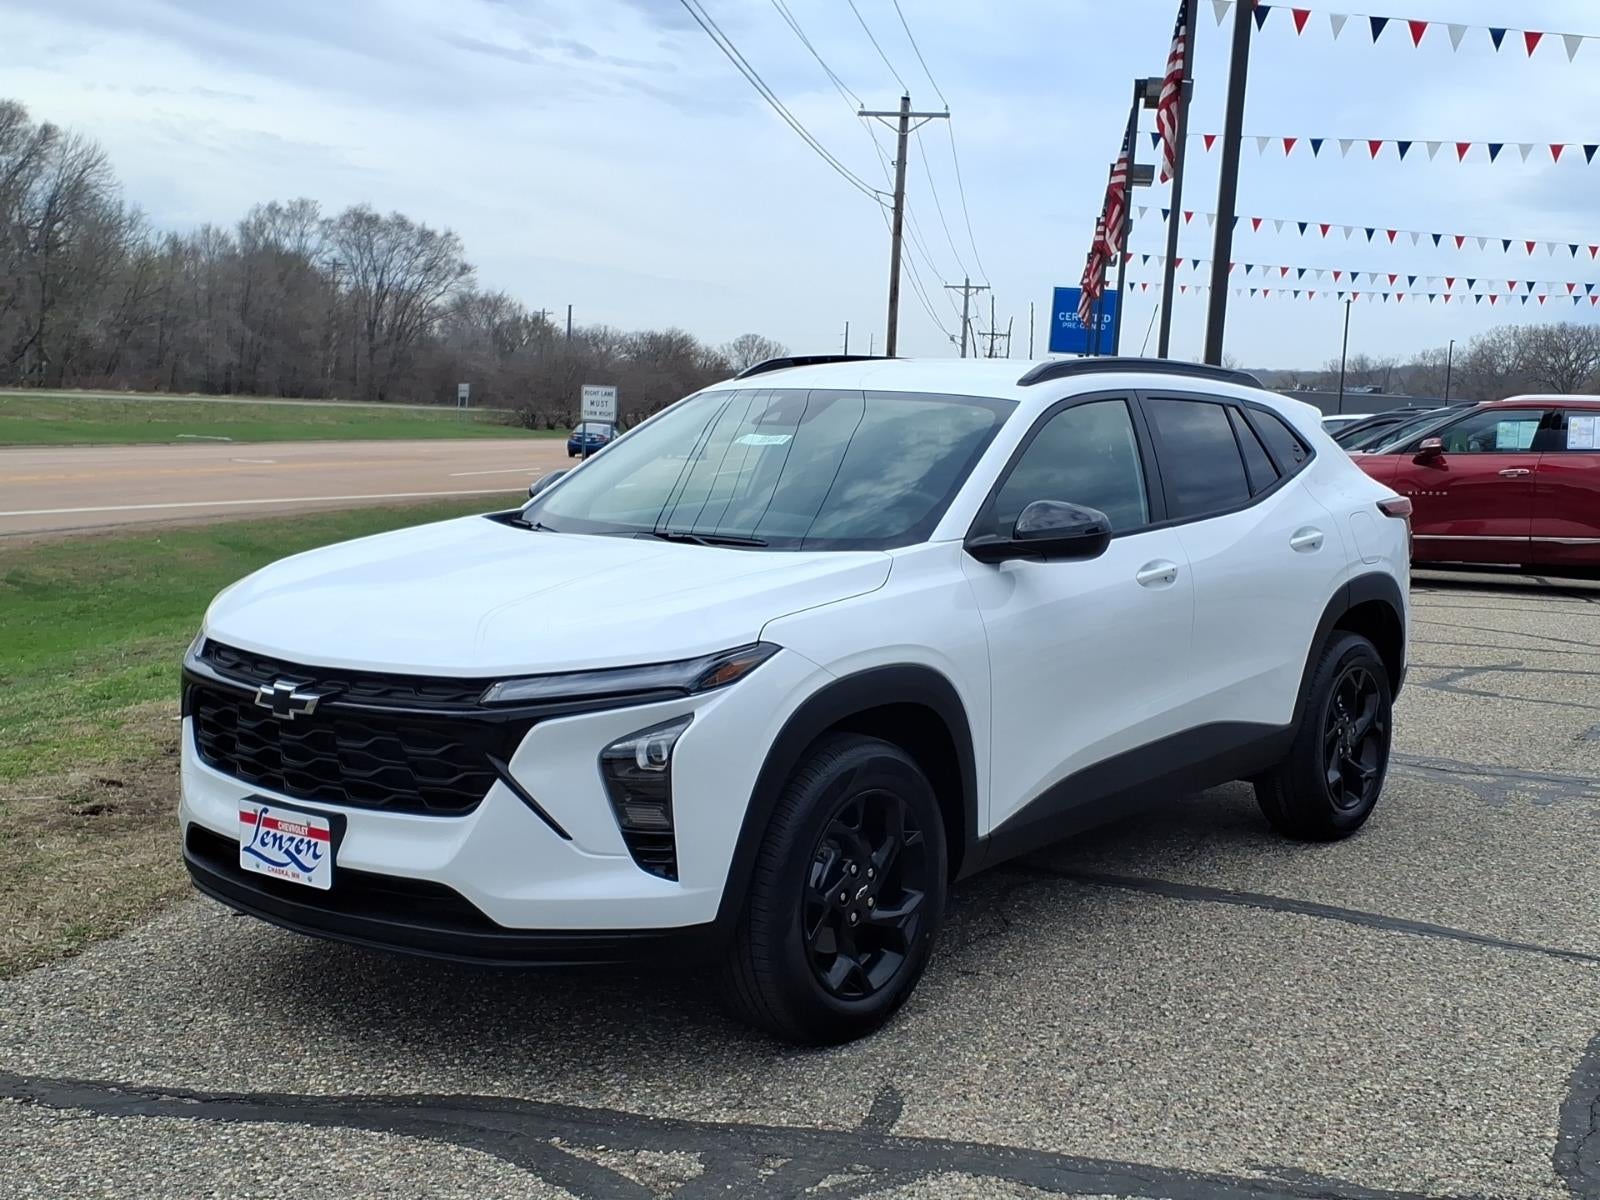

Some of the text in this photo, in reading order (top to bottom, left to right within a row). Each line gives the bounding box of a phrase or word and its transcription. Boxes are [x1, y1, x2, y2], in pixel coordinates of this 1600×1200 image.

[590, 400, 609, 408] MUST
[277, 821, 309, 836] CHEVROLET
[242, 807, 324, 873] Lenzen
